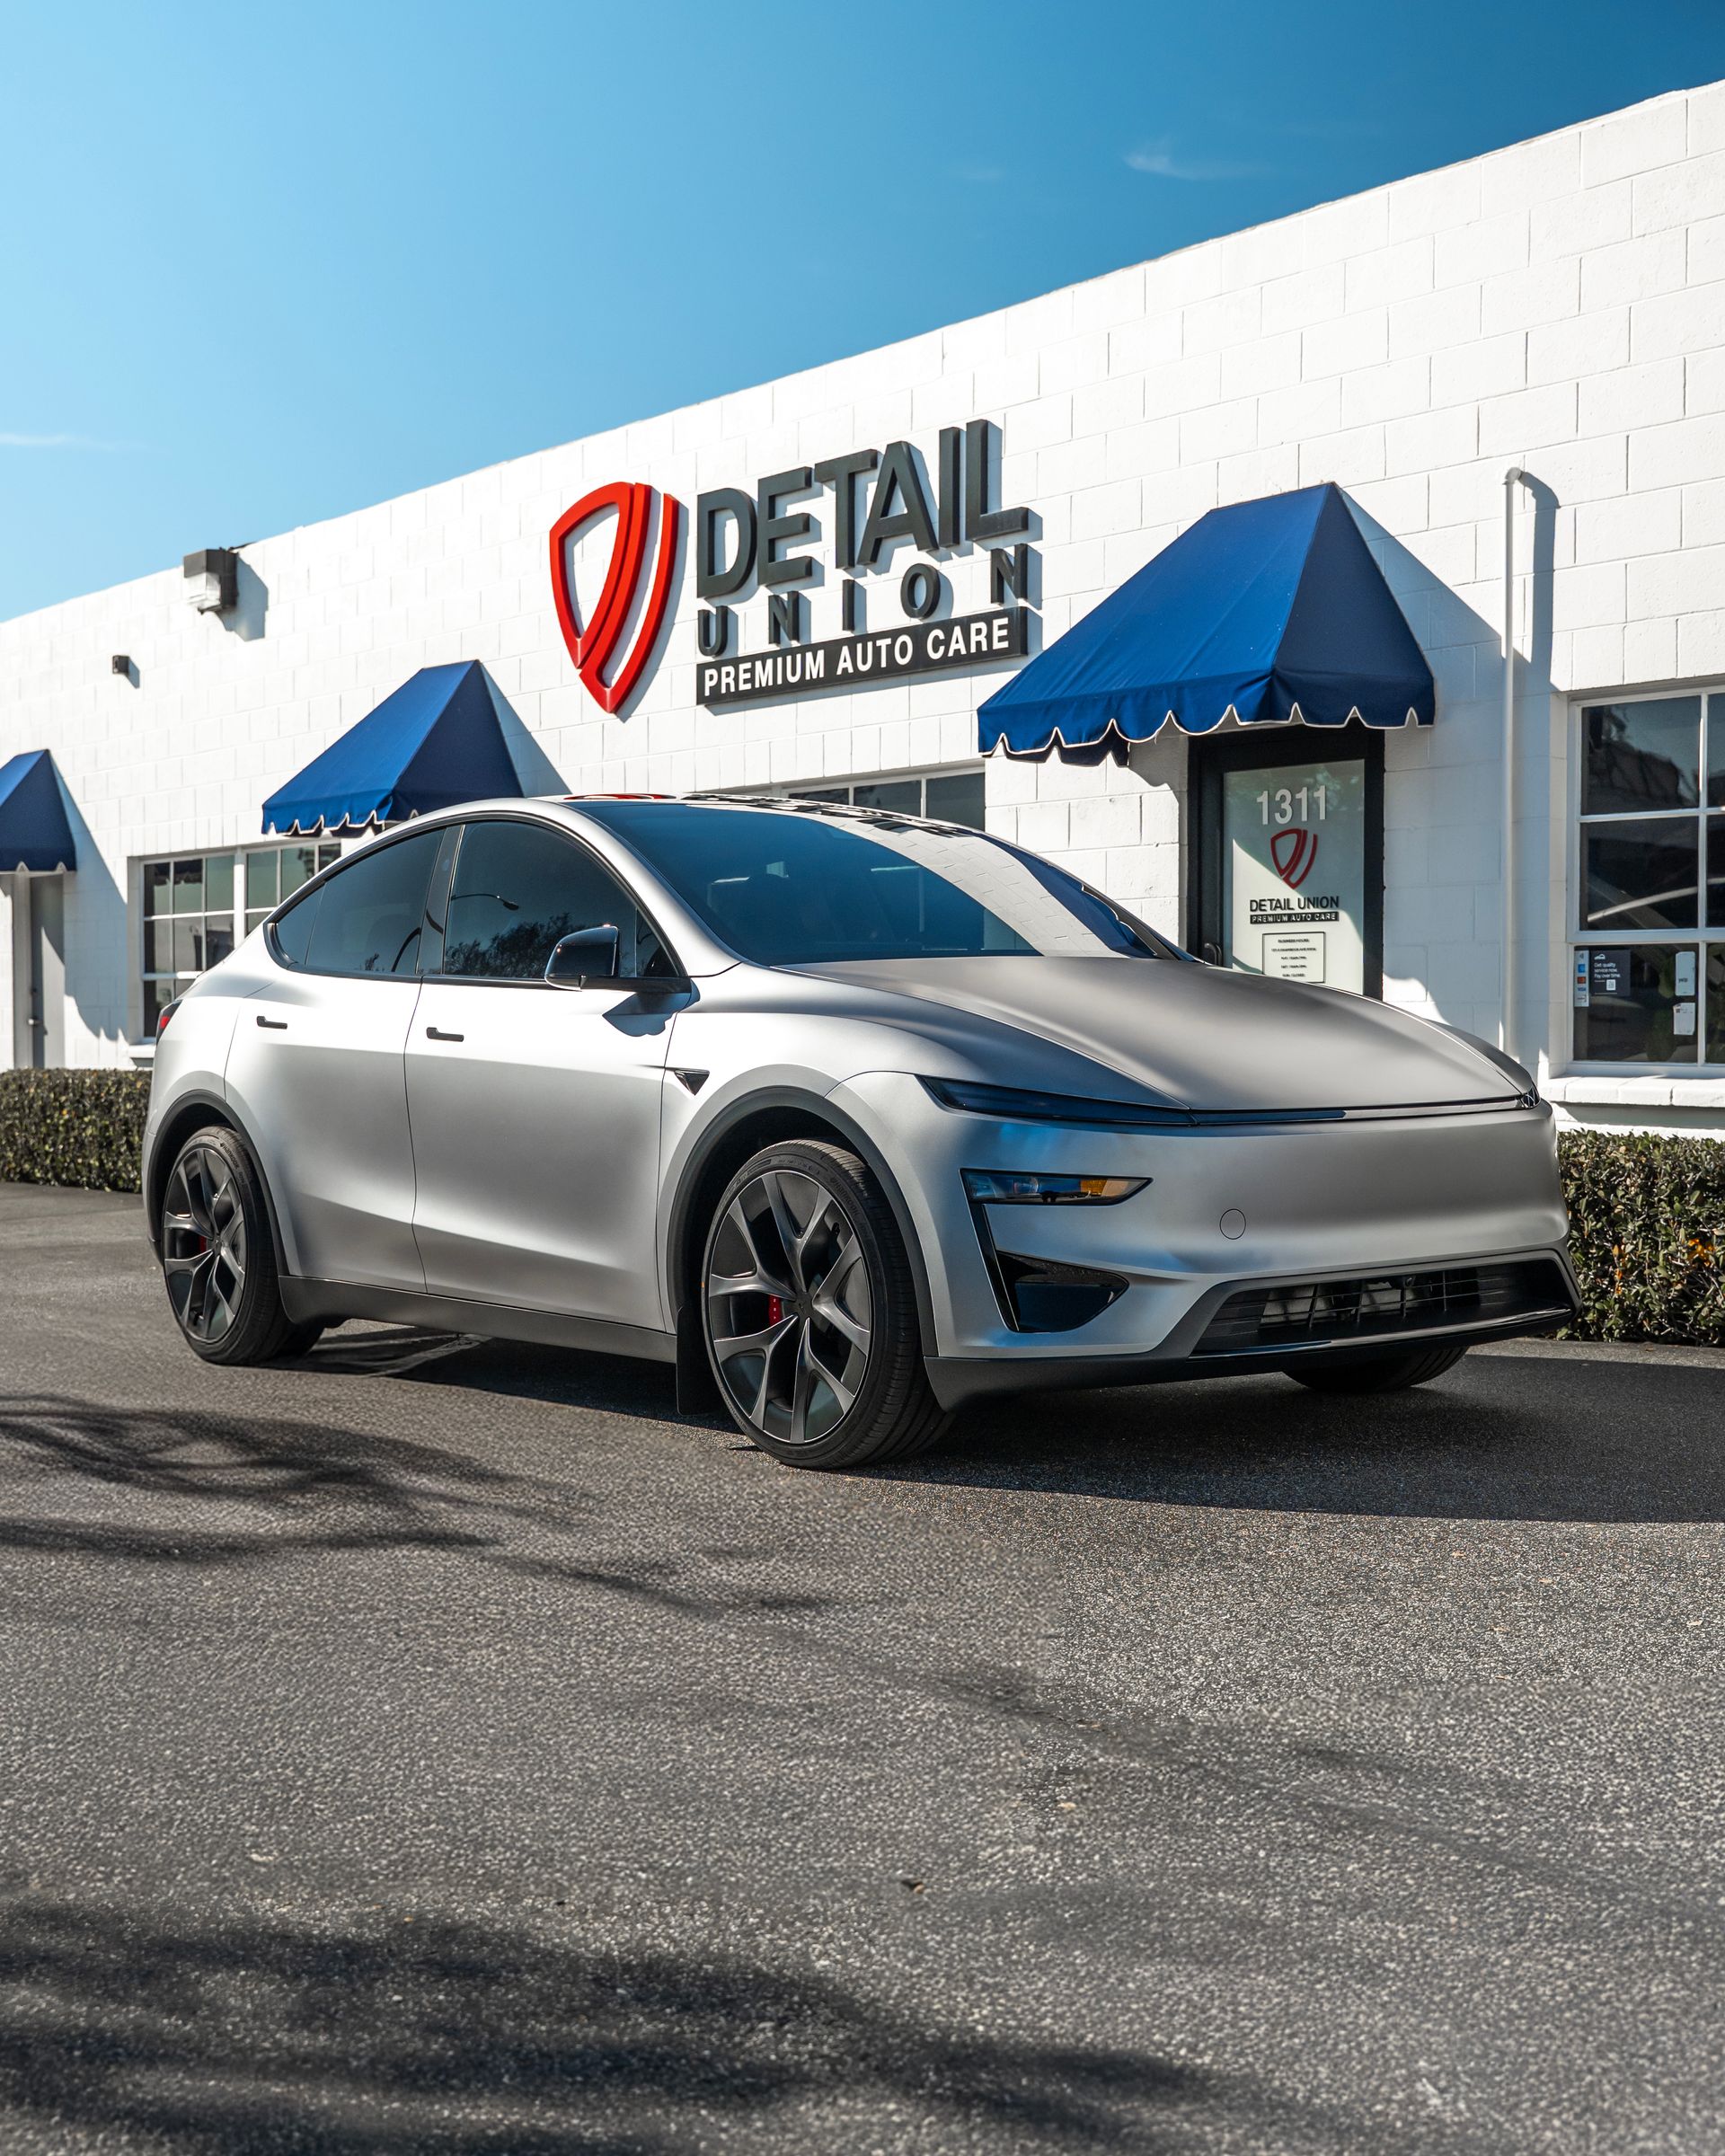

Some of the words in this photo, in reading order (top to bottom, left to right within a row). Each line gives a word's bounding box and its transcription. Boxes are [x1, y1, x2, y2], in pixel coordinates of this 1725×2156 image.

[696, 419, 1030, 599] DETAIL
[697, 543, 1029, 658] UNION
[703, 649, 825, 697] PREMIUM
[836, 634, 914, 676] AUTO
[925, 617, 1011, 661] CARE
[1256, 785, 1326, 826] 1311
[1249, 897, 1295, 913] DETAIL
[1297, 896, 1340, 911] UNION
[1252, 915, 1288, 923] PREMIUM
[1290, 914, 1312, 922] AUTO
[1314, 912, 1337, 921] CARE
